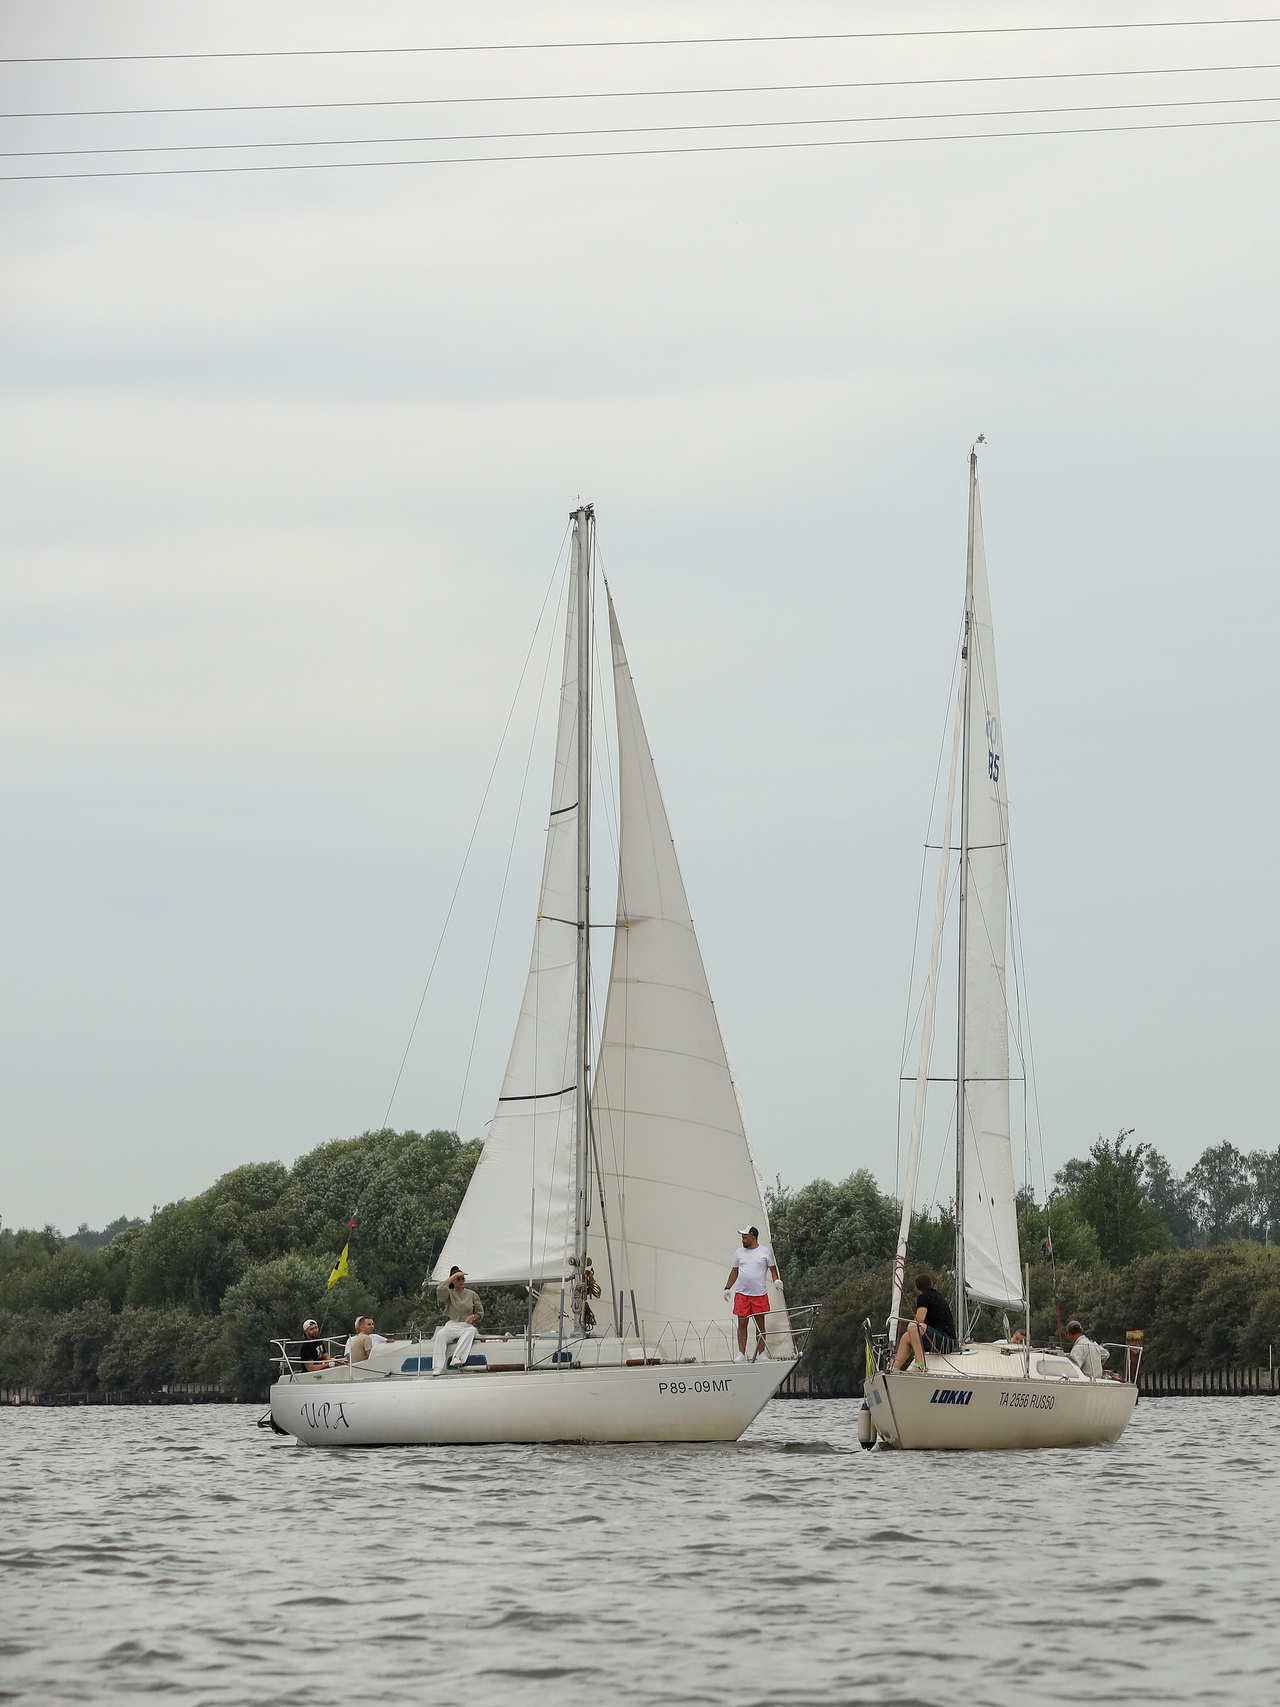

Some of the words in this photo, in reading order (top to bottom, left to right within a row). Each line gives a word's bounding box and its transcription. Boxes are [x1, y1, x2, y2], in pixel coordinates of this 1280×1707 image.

[929, 1389, 973, 1405] LOKKI
[1000, 1392, 1009, 1406] TA
[1010, 1393, 1030, 1408] 2556
[1030, 1394, 1055, 1410] RUS50
